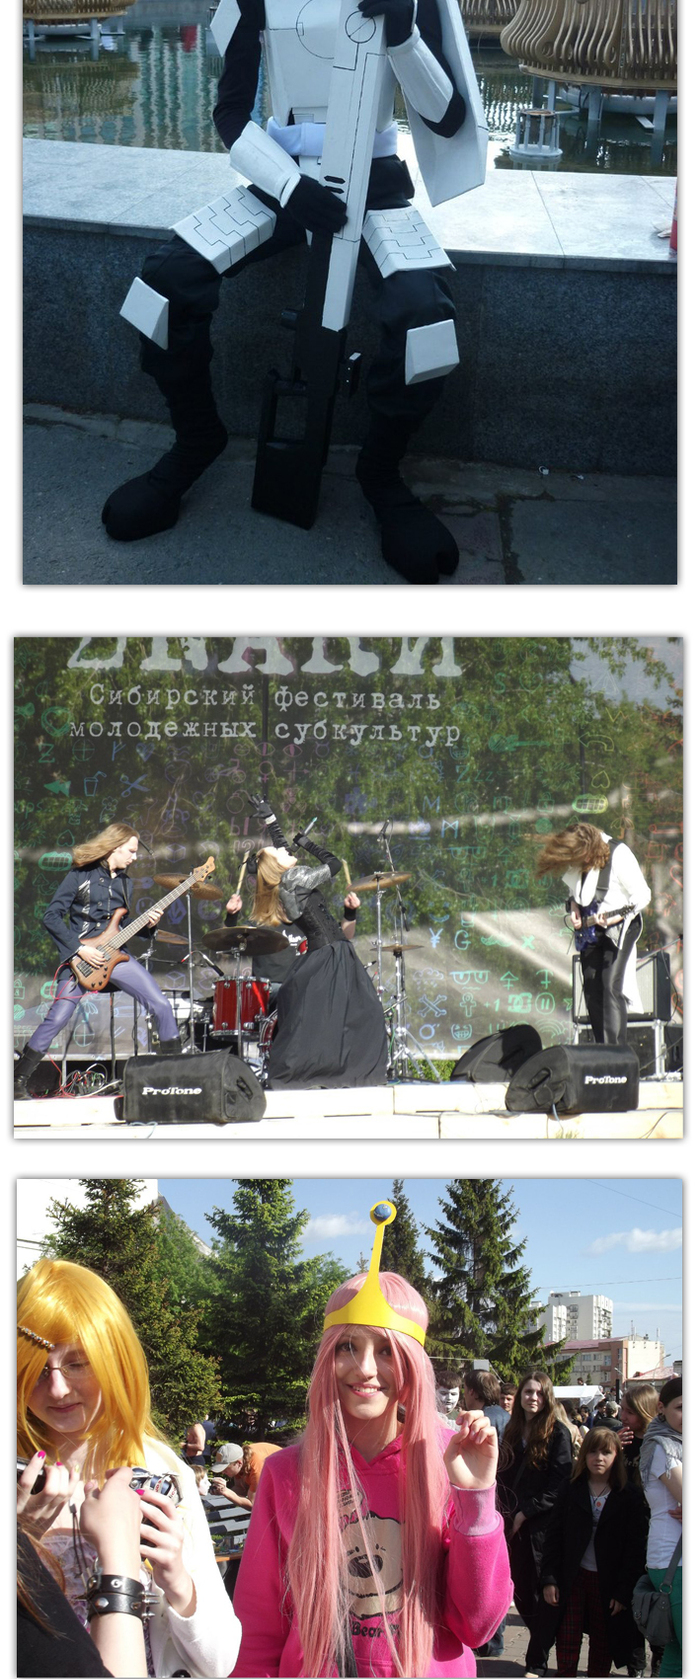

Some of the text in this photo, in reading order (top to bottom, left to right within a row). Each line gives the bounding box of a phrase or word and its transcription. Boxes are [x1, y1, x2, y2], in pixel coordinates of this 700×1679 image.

[90, 683, 441, 712] Сибирский фестиваль
[70, 721, 460, 747] молодежных субкультур
[584, 1075, 628, 1084] ProTone
[141, 1086, 202, 1095] ProTone
[351, 1621, 382, 1637] Bear
